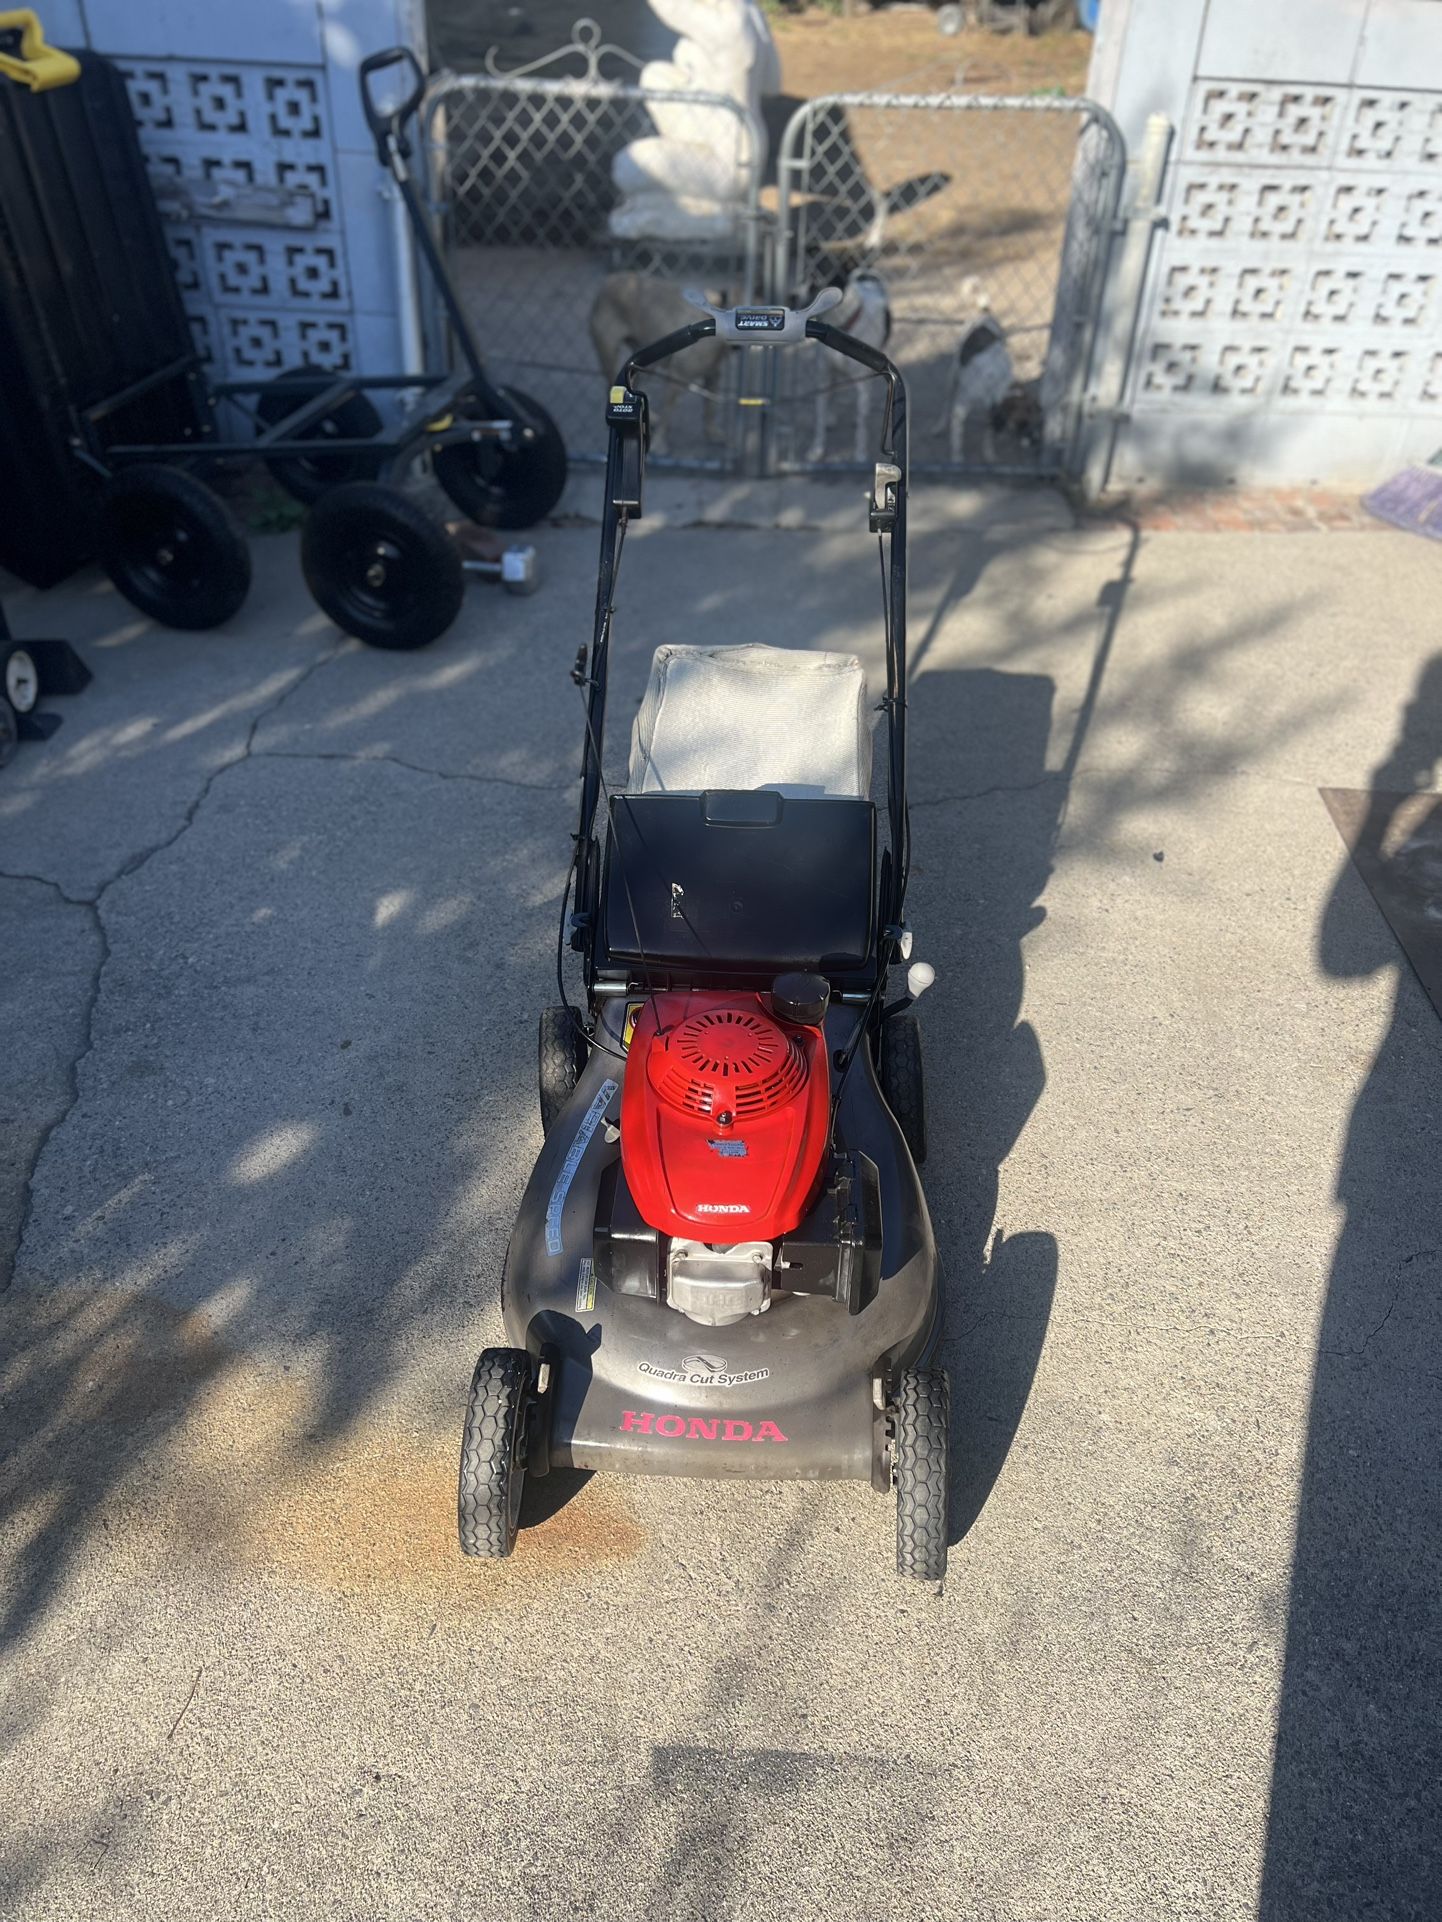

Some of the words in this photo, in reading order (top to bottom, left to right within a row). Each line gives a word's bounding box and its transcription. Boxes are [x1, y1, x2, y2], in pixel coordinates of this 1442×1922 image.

[557, 1084, 617, 1185] VARIABLE
[548, 1190, 565, 1252] SPEED
[697, 1204, 750, 1213] HONDA
[638, 1362, 687, 1383] Quadra
[690, 1373, 715, 1384] Cut
[717, 1368, 769, 1386] System
[619, 1410, 789, 1442] HONDA
